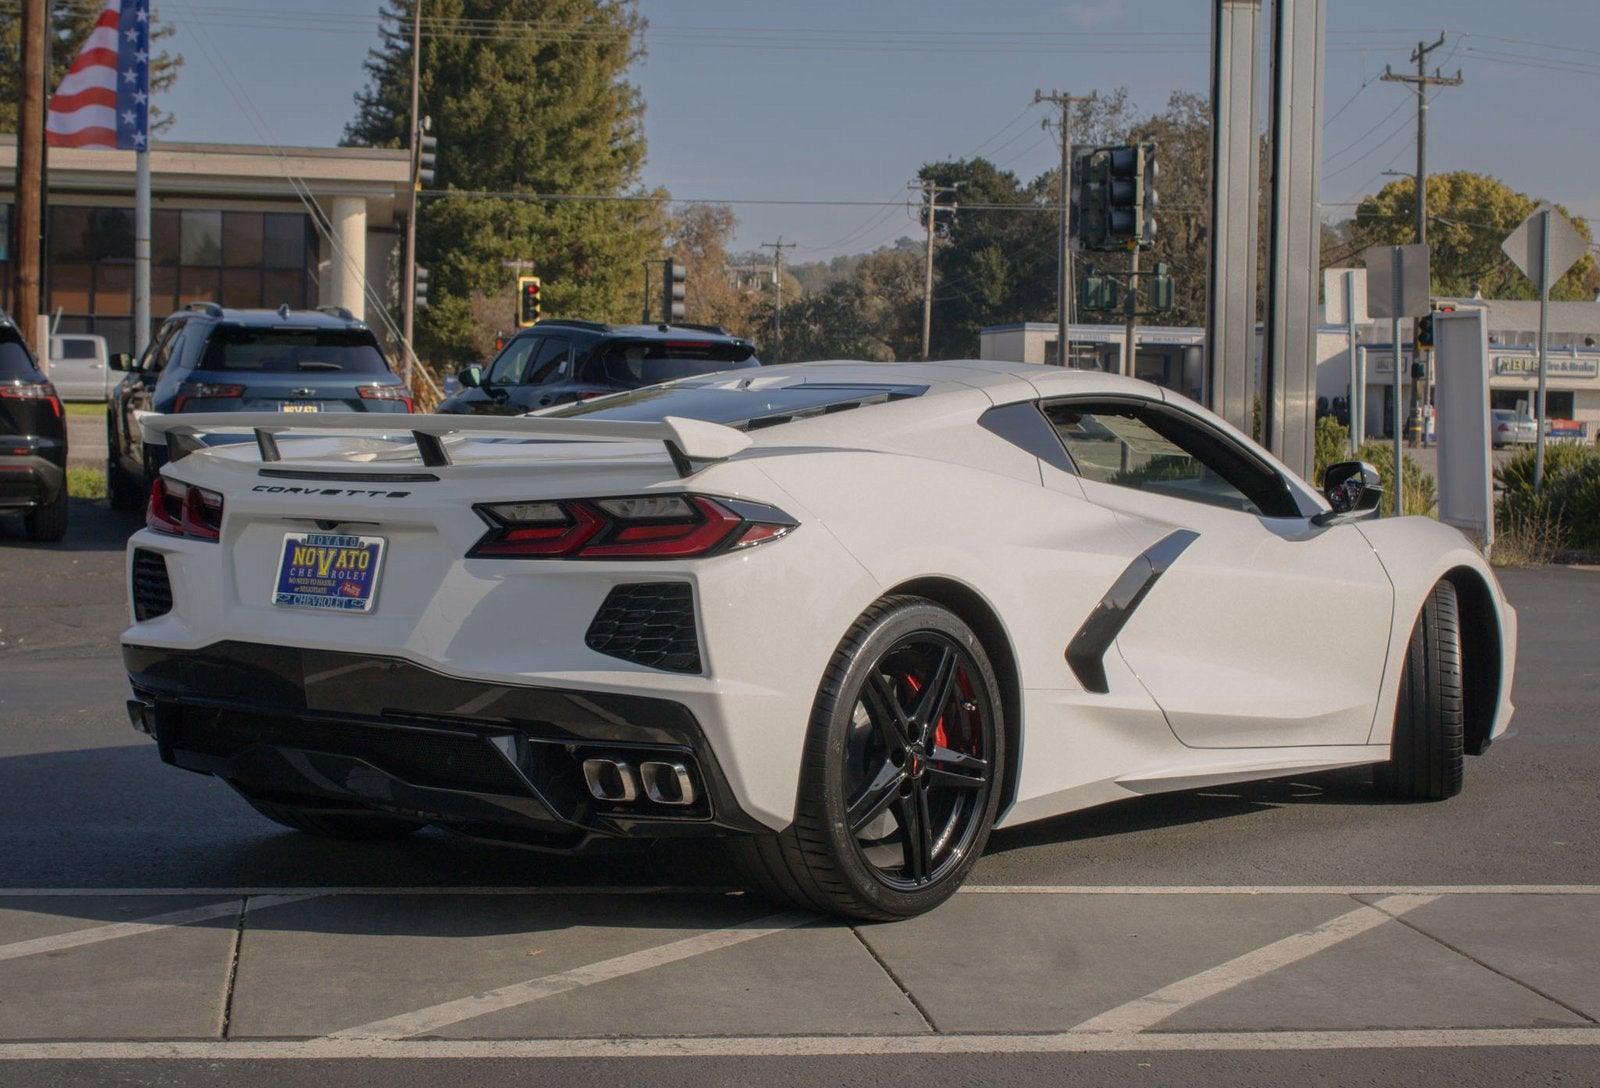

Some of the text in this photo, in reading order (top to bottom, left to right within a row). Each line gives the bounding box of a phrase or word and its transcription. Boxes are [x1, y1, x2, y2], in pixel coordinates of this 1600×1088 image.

[252, 485, 412, 498] CORVETTE
[308, 536, 357, 546] NOVATO
[293, 547, 370, 576] NOVATO
[293, 596, 347, 609] CHEVROLET
